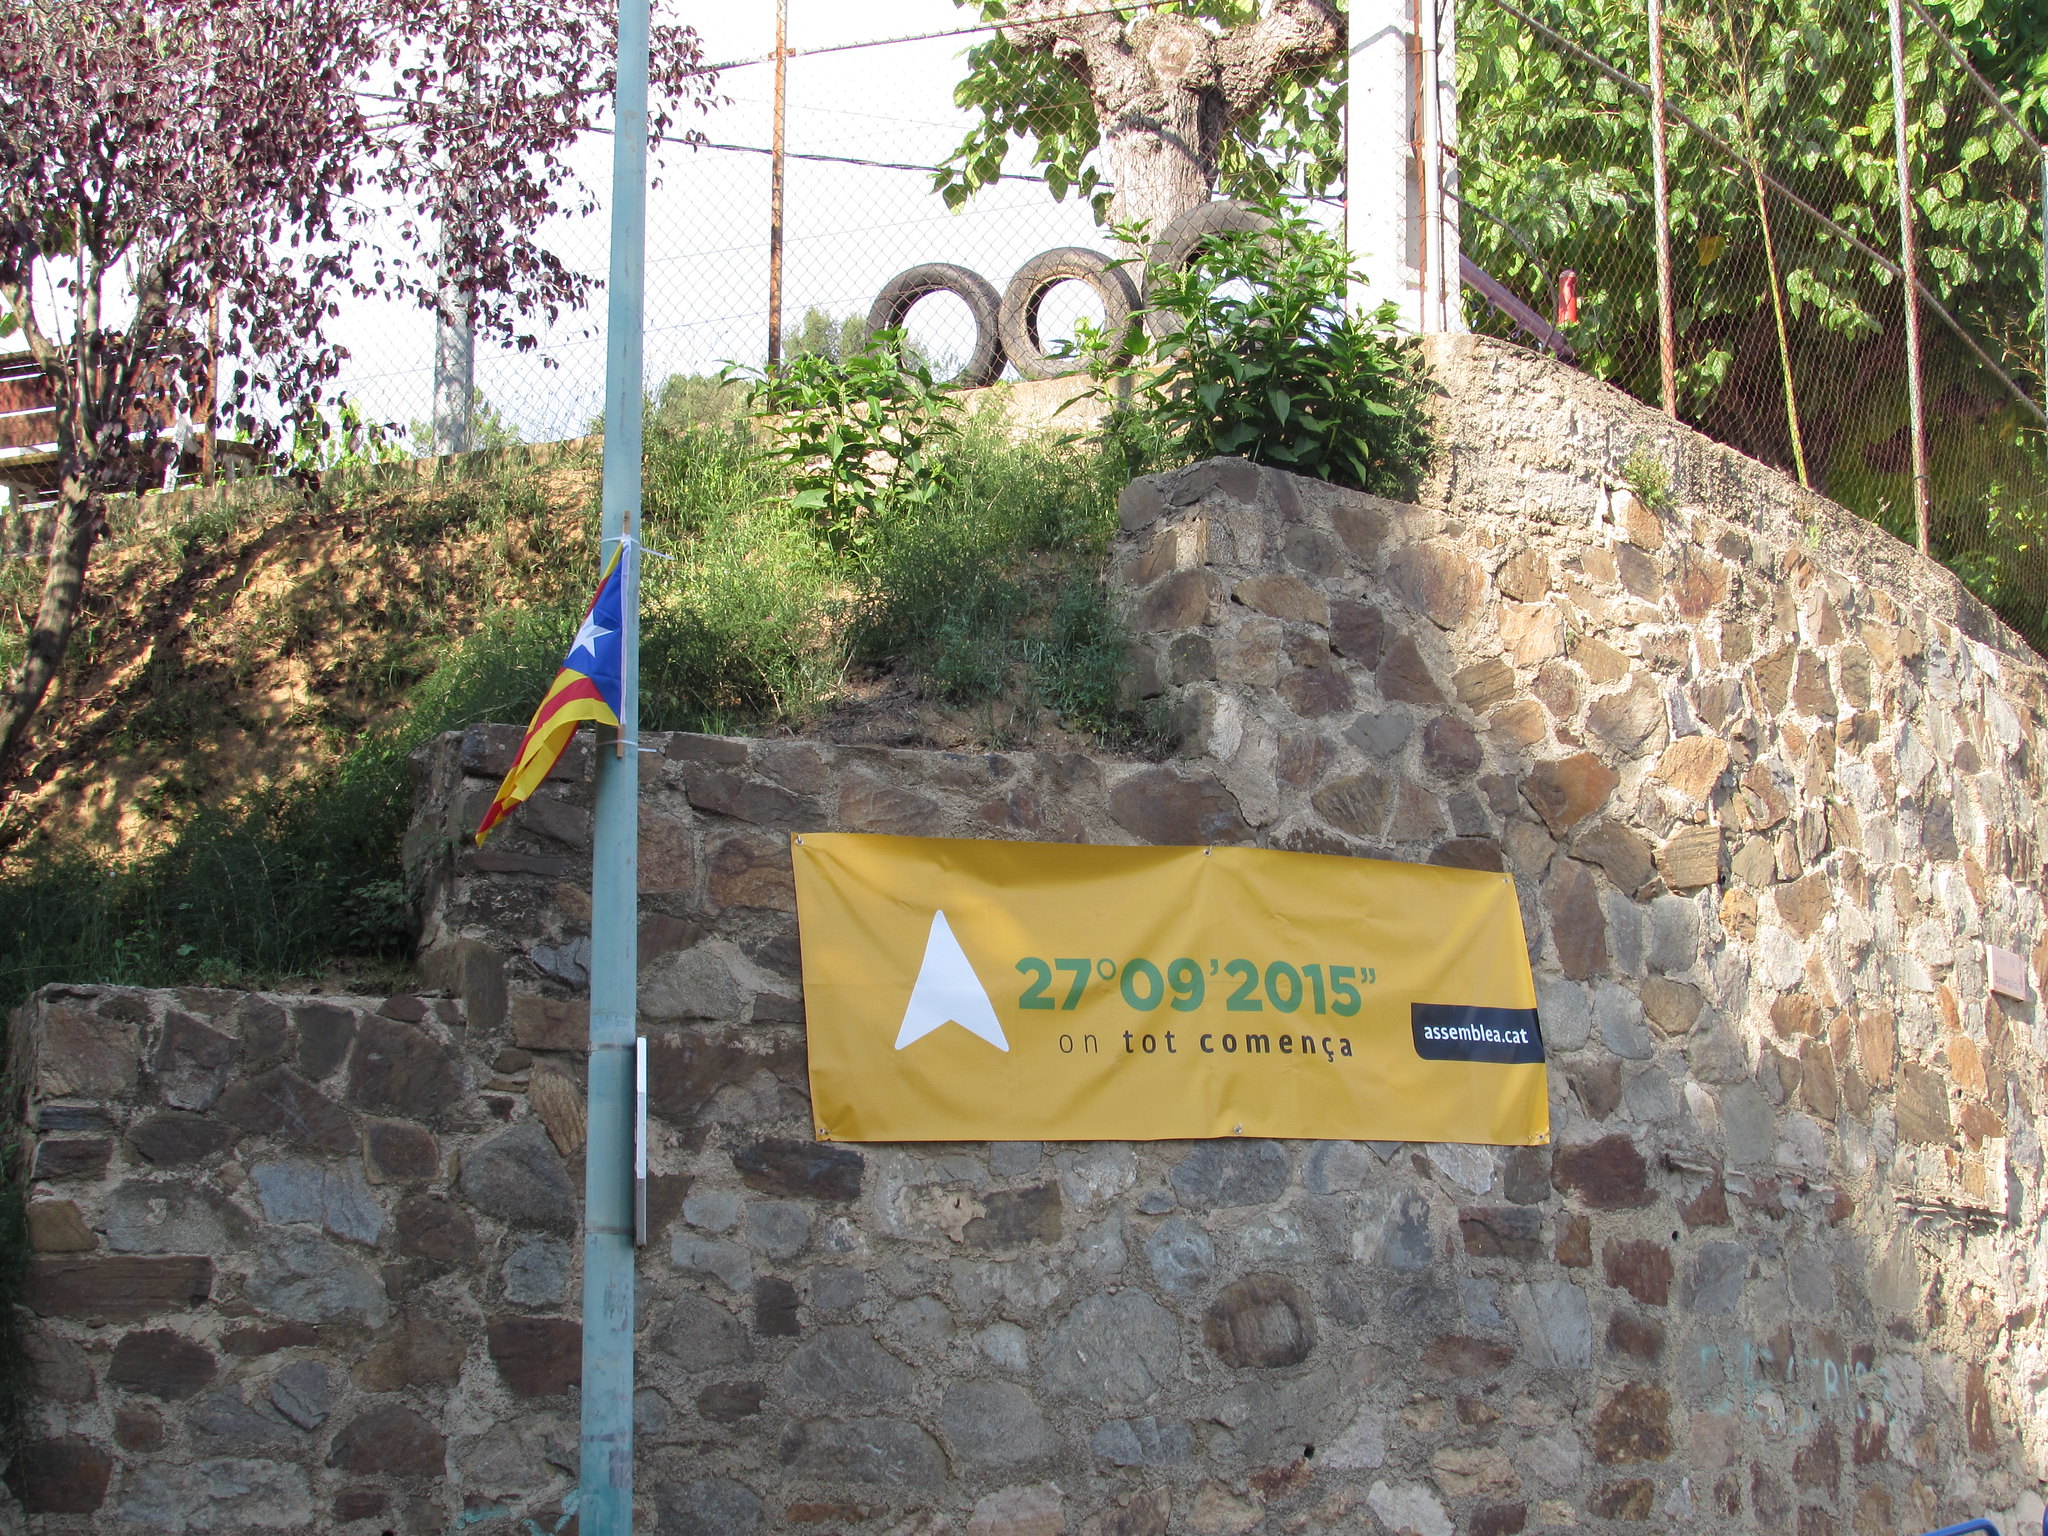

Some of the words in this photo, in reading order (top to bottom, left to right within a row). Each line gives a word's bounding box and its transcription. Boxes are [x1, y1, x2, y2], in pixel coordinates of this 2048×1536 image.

[1059, 1034, 1099, 1053] on
[1123, 1030, 1177, 1054] tot
[1200, 1032, 1353, 1063] comença
[1424, 1024, 1529, 1044] assemblea.cat
